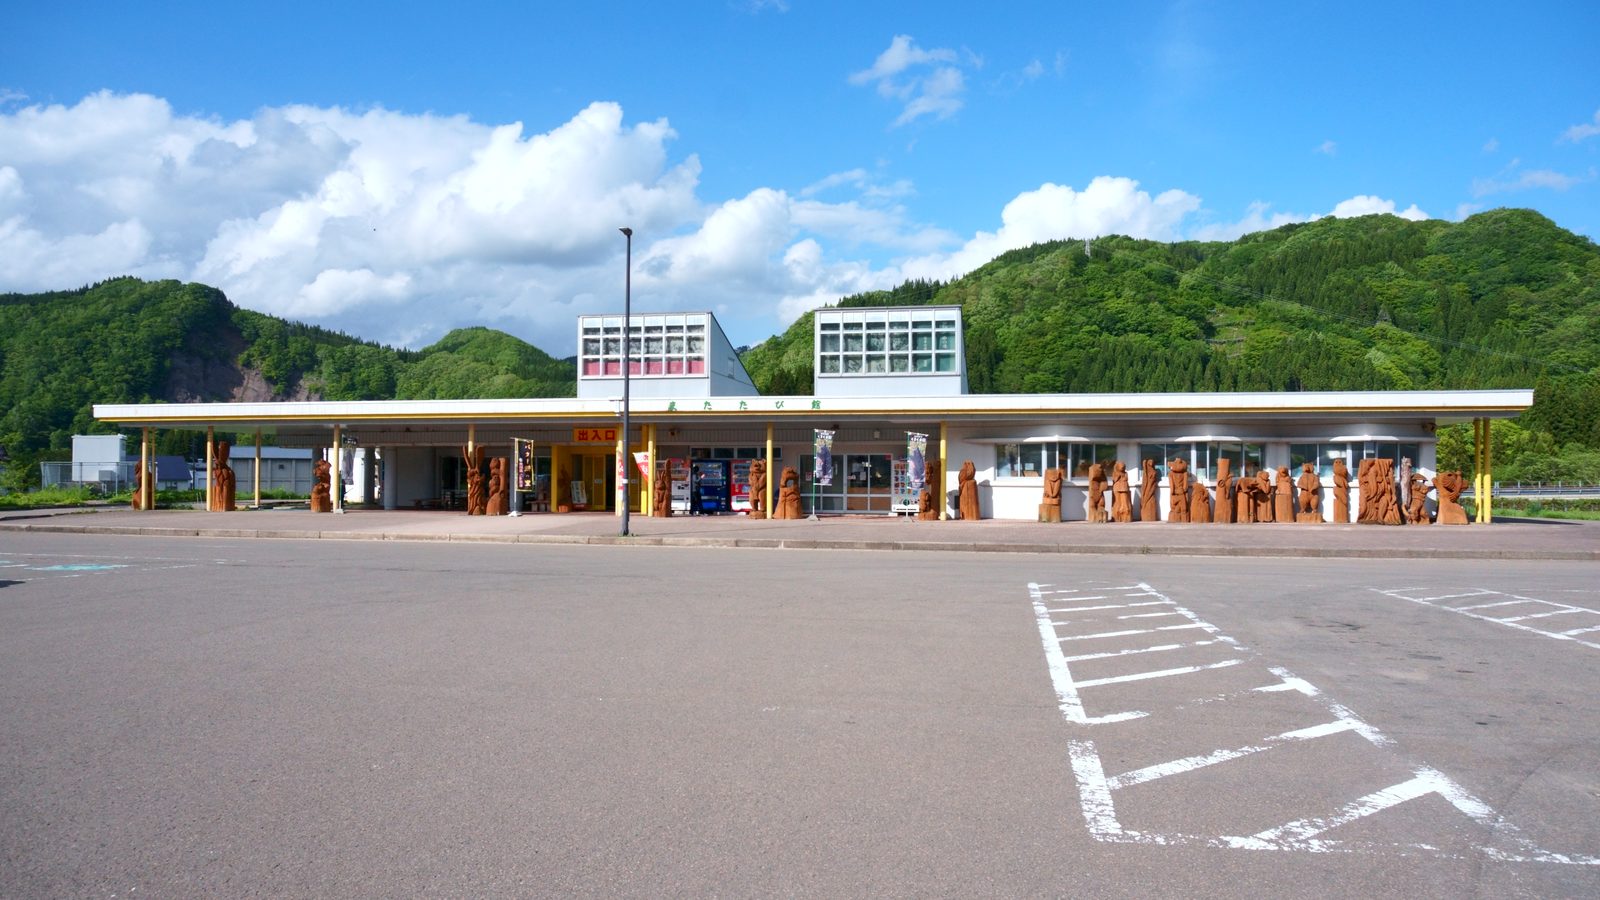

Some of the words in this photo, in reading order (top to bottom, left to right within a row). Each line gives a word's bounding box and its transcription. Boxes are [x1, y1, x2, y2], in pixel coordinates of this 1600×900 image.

[668, 400, 821, 411] またたび館
[578, 430, 616, 441] 出入口
